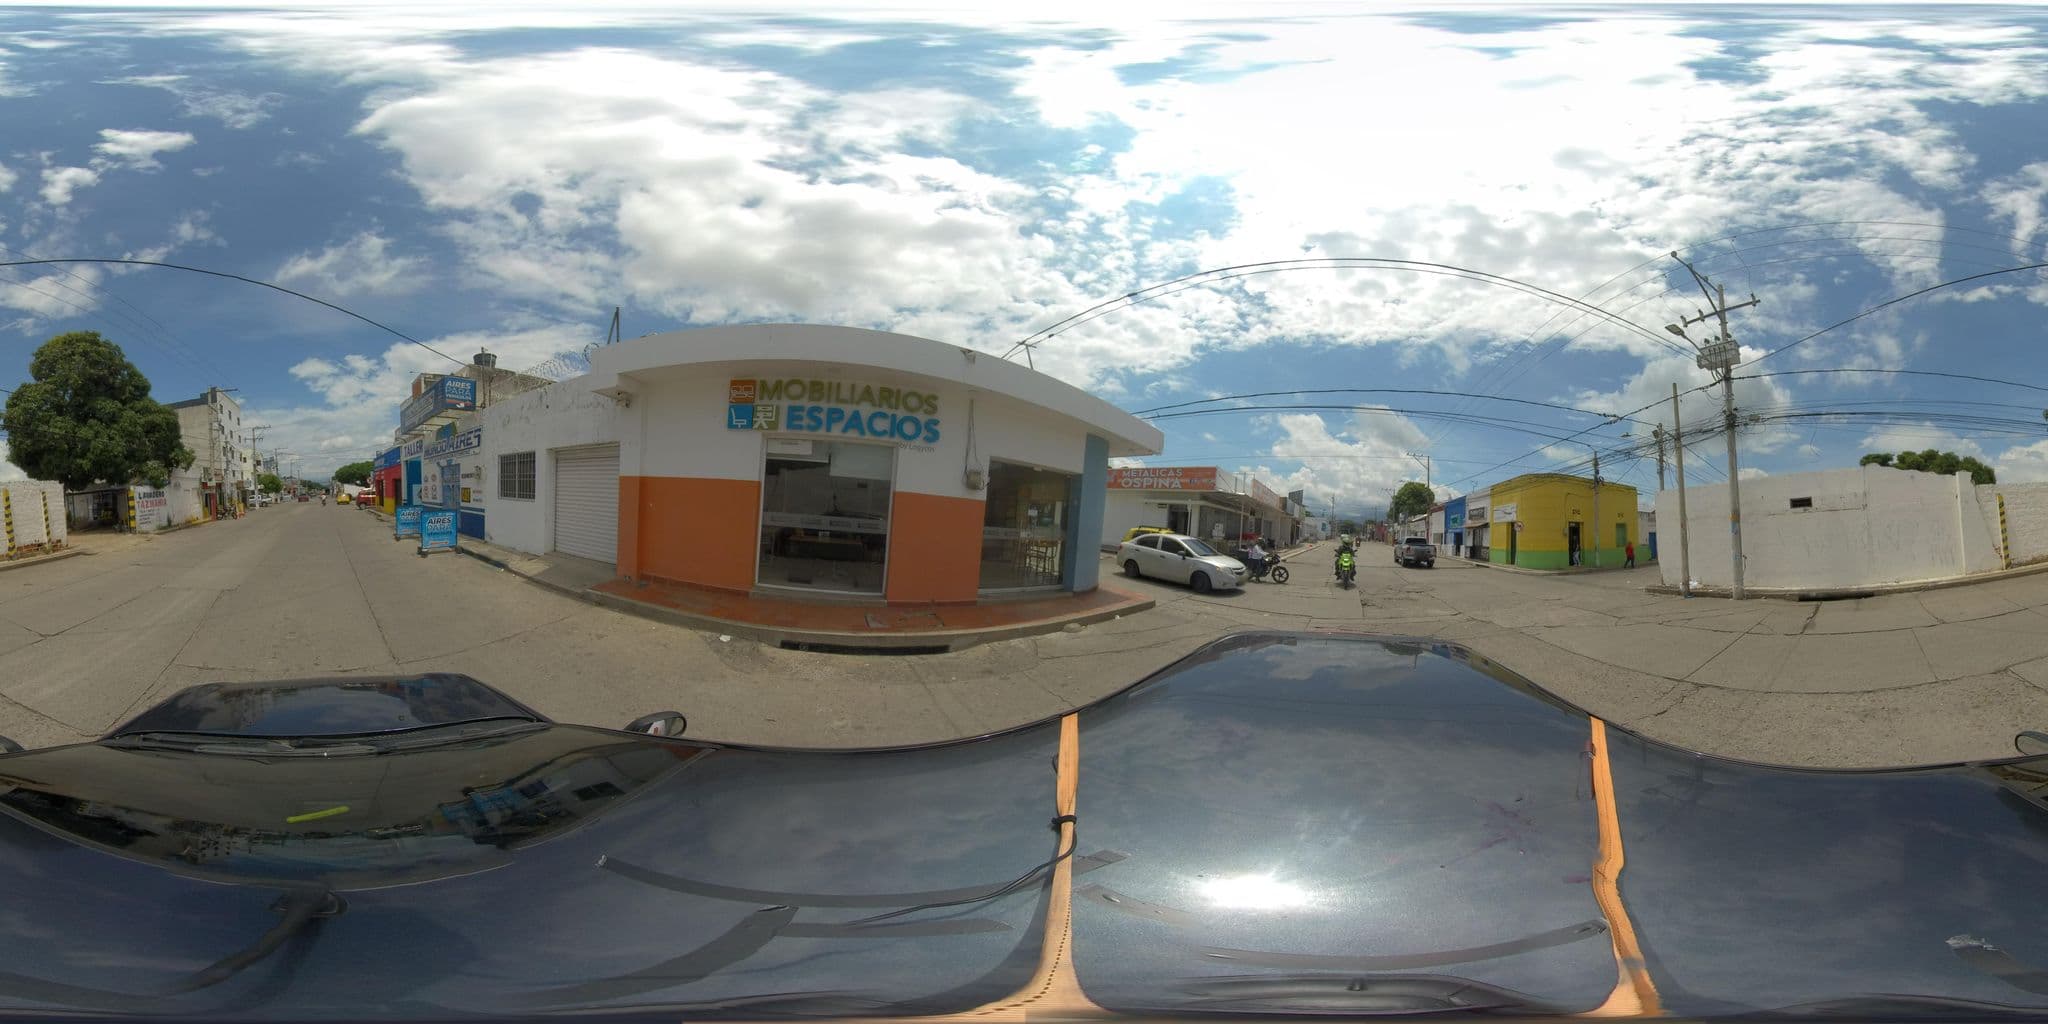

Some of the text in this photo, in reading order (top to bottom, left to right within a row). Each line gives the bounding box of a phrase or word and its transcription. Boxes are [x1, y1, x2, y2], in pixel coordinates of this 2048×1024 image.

[446, 380, 471, 389] AIRES
[446, 387, 472, 396] PARA
[758, 379, 939, 415] MOBILIARIOS
[786, 405, 941, 443] ESPACIOS
[404, 439, 423, 457] TALLER
[1122, 469, 1183, 478] METALICAS
[1121, 478, 1183, 489] OSPINA
[401, 510, 420, 518] AIRES
[427, 517, 452, 525] AIRES
